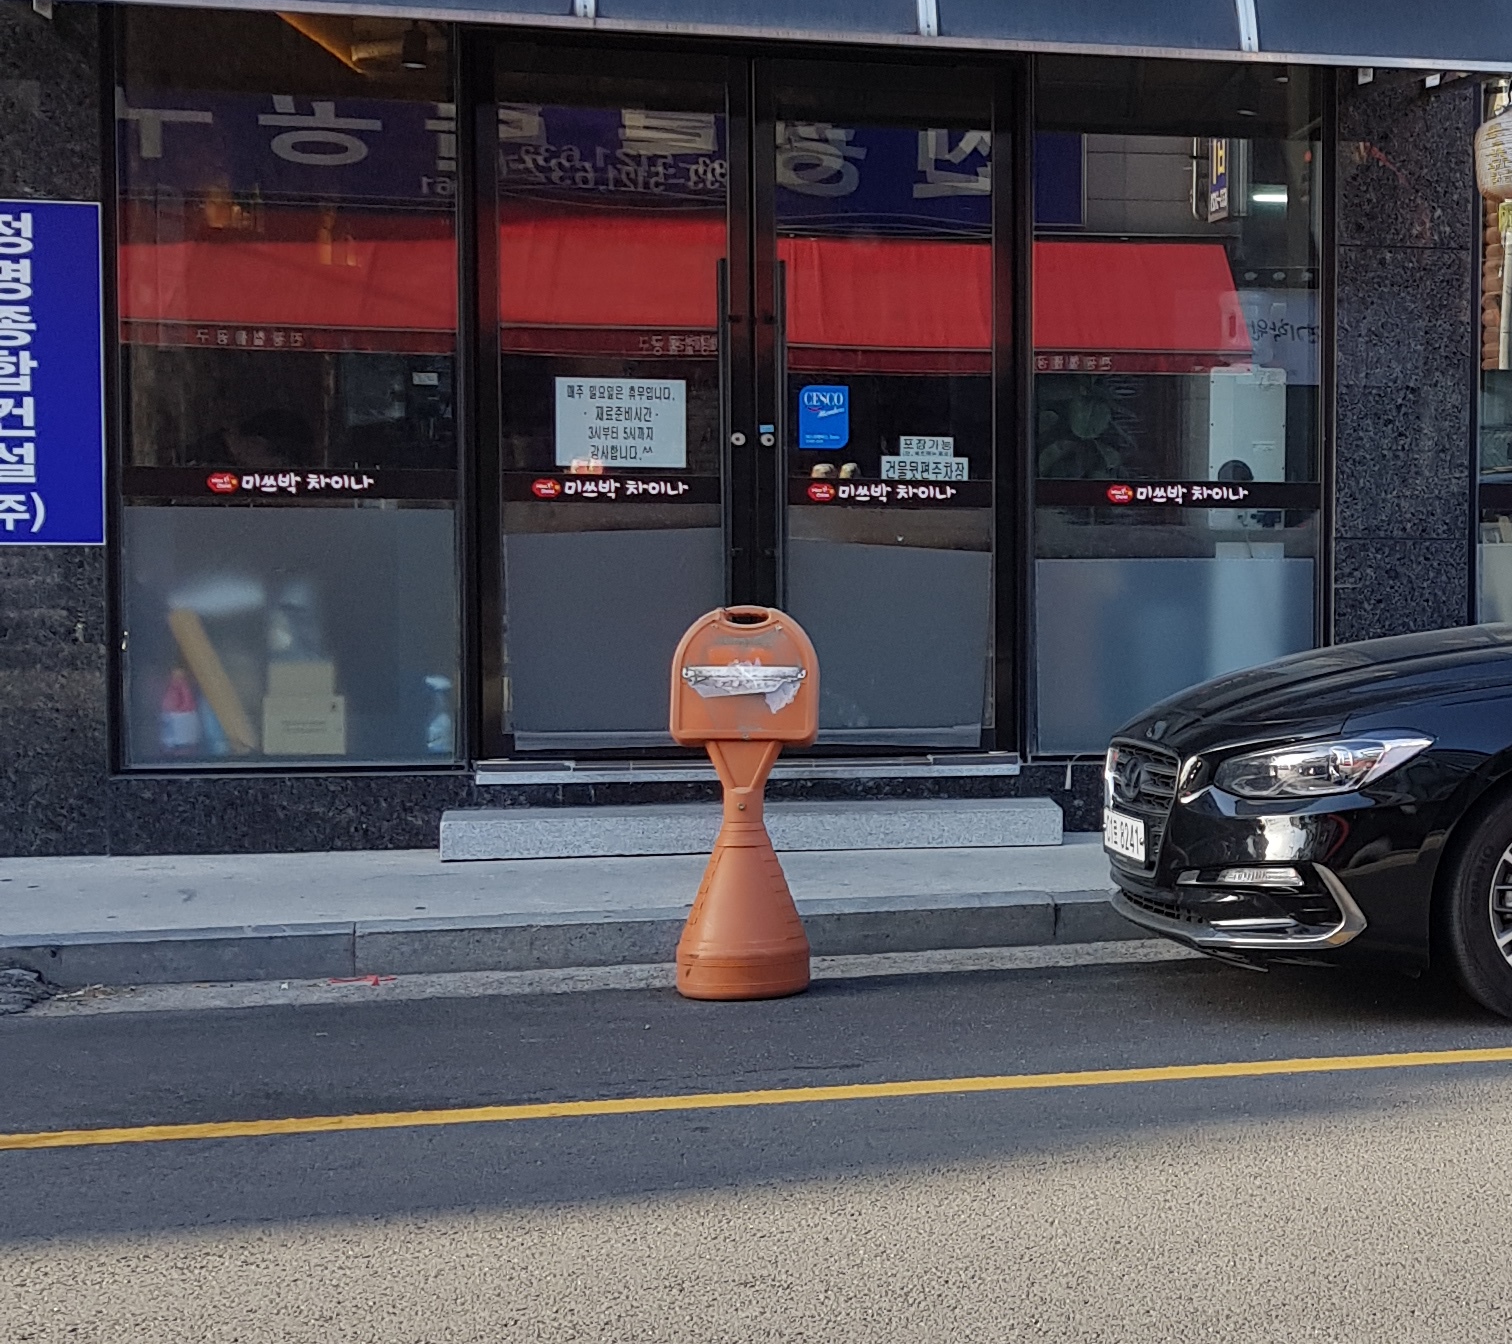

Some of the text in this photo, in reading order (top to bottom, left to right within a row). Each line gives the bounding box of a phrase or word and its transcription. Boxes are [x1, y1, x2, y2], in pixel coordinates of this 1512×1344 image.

[566, 384, 676, 401] 매주 일요일은 휴무입니다.
[803, 391, 844, 406] CESCO
[595, 405, 653, 422] 재료준비시간
[588, 426, 654, 441] 3시부터 5시까지
[241, 472, 302, 494] 미쓰박
[306, 474, 375, 491] 차이나
[564, 478, 621, 499] 미쓰박
[625, 480, 690, 496] 차이나
[838, 483, 893, 503] 미쓰박
[896, 484, 957, 500] 차이나
[1136, 485, 1188, 504] 미쓰박
[1191, 486, 1249, 501] 차이나
